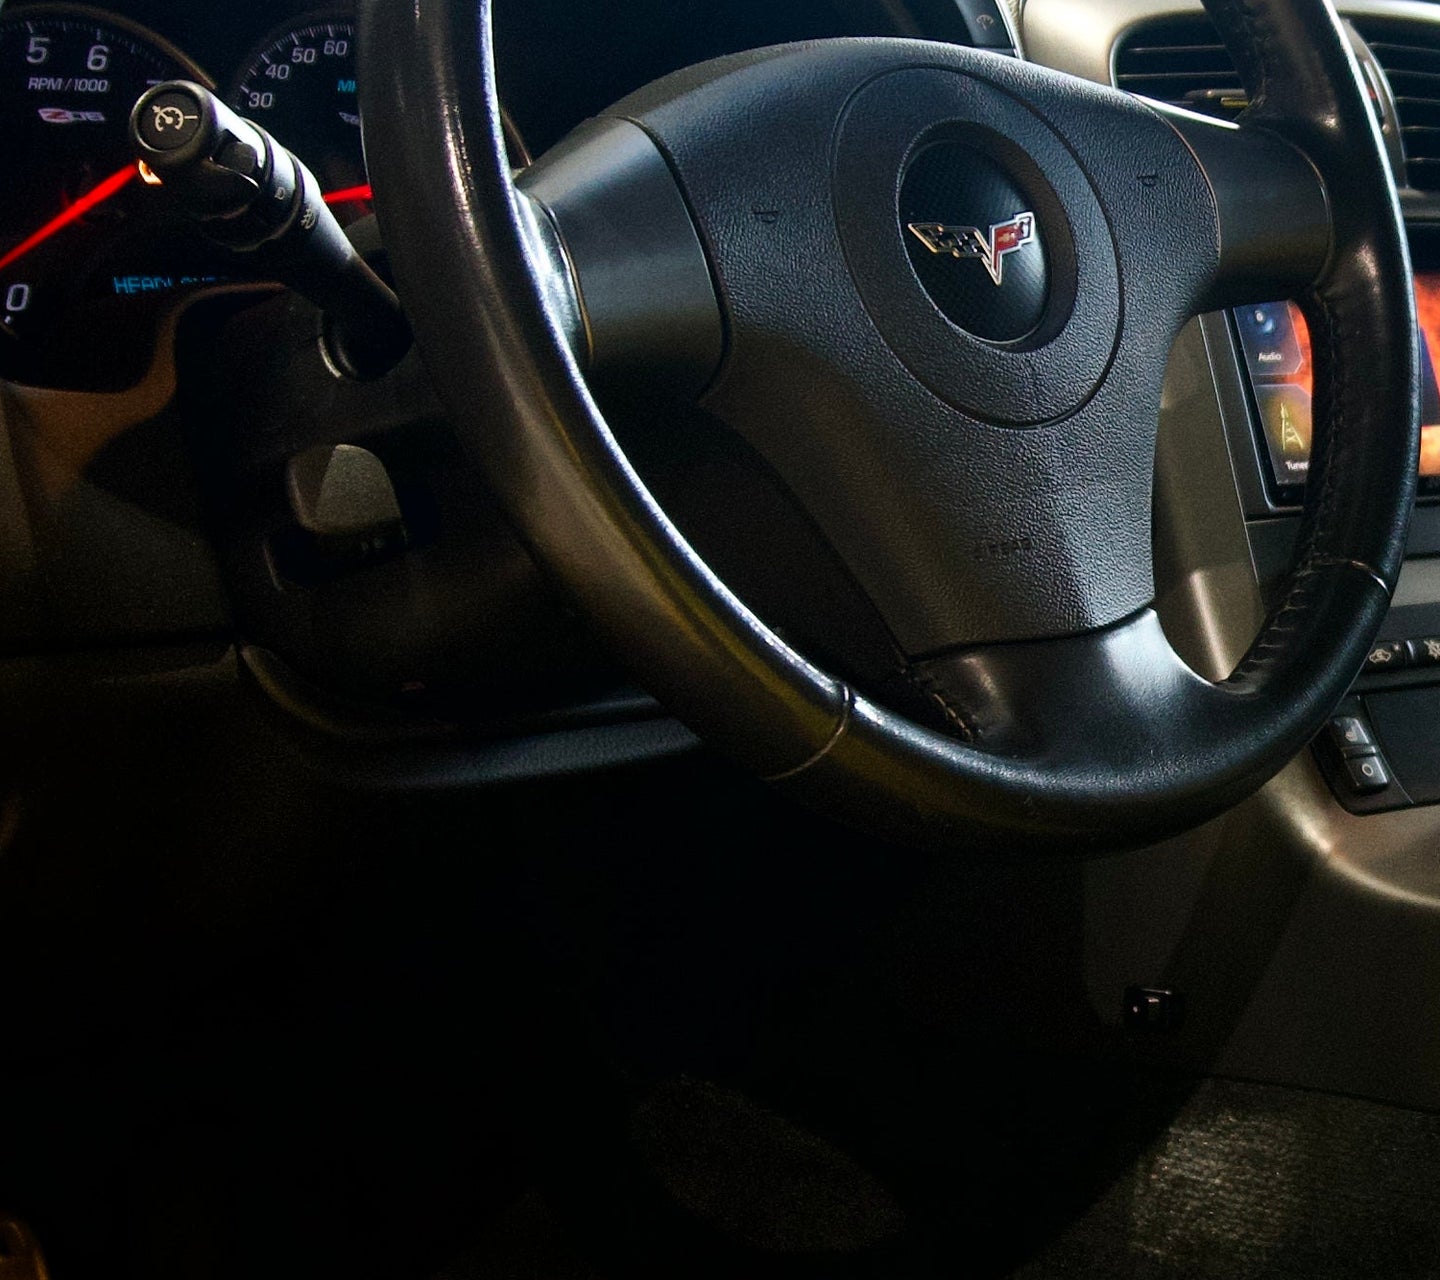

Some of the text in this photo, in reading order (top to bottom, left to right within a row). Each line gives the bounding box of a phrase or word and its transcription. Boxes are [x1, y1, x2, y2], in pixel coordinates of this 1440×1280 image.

[26, 37, 50, 64] 5
[291, 48, 316, 63] 50
[323, 40, 348, 56] 60
[86, 45, 109, 71] 6
[265, 64, 290, 80] 40
[248, 92, 273, 108] 30
[5, 284, 29, 311] 0
[1258, 352, 1282, 362] Audio
[1285, 461, 1310, 470] Tuner
